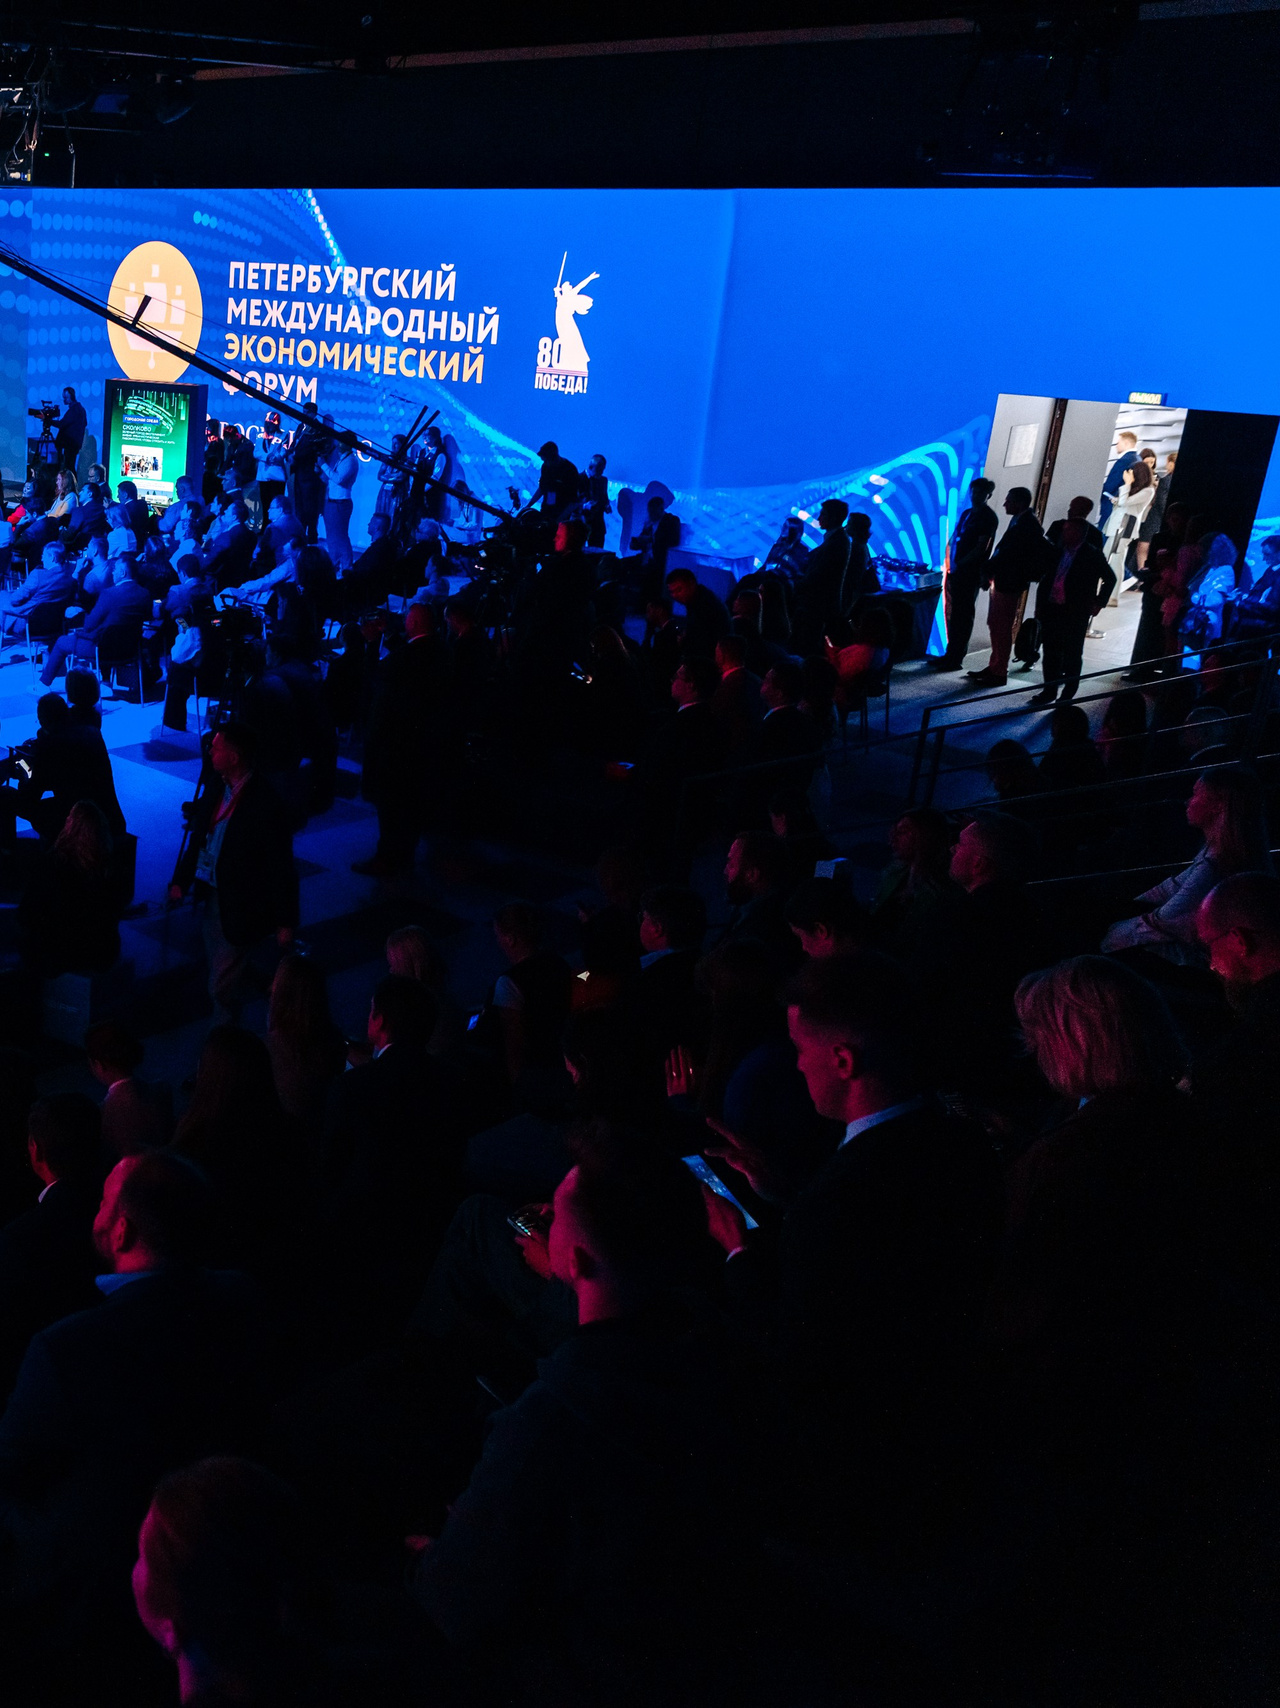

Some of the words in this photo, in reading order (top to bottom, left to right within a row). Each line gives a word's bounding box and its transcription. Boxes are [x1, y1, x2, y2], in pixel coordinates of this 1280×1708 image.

[228, 261, 457, 301] ПЕТЕРБУРГСКИЙ
[226, 297, 500, 345] МЕЖДУНАРОДНЫЙ
[223, 332, 485, 384] ЭКОНОМИЧЕСКИЙ
[222, 368, 318, 404] ФОРУМ
[534, 373, 588, 395] ПОБЕДА!
